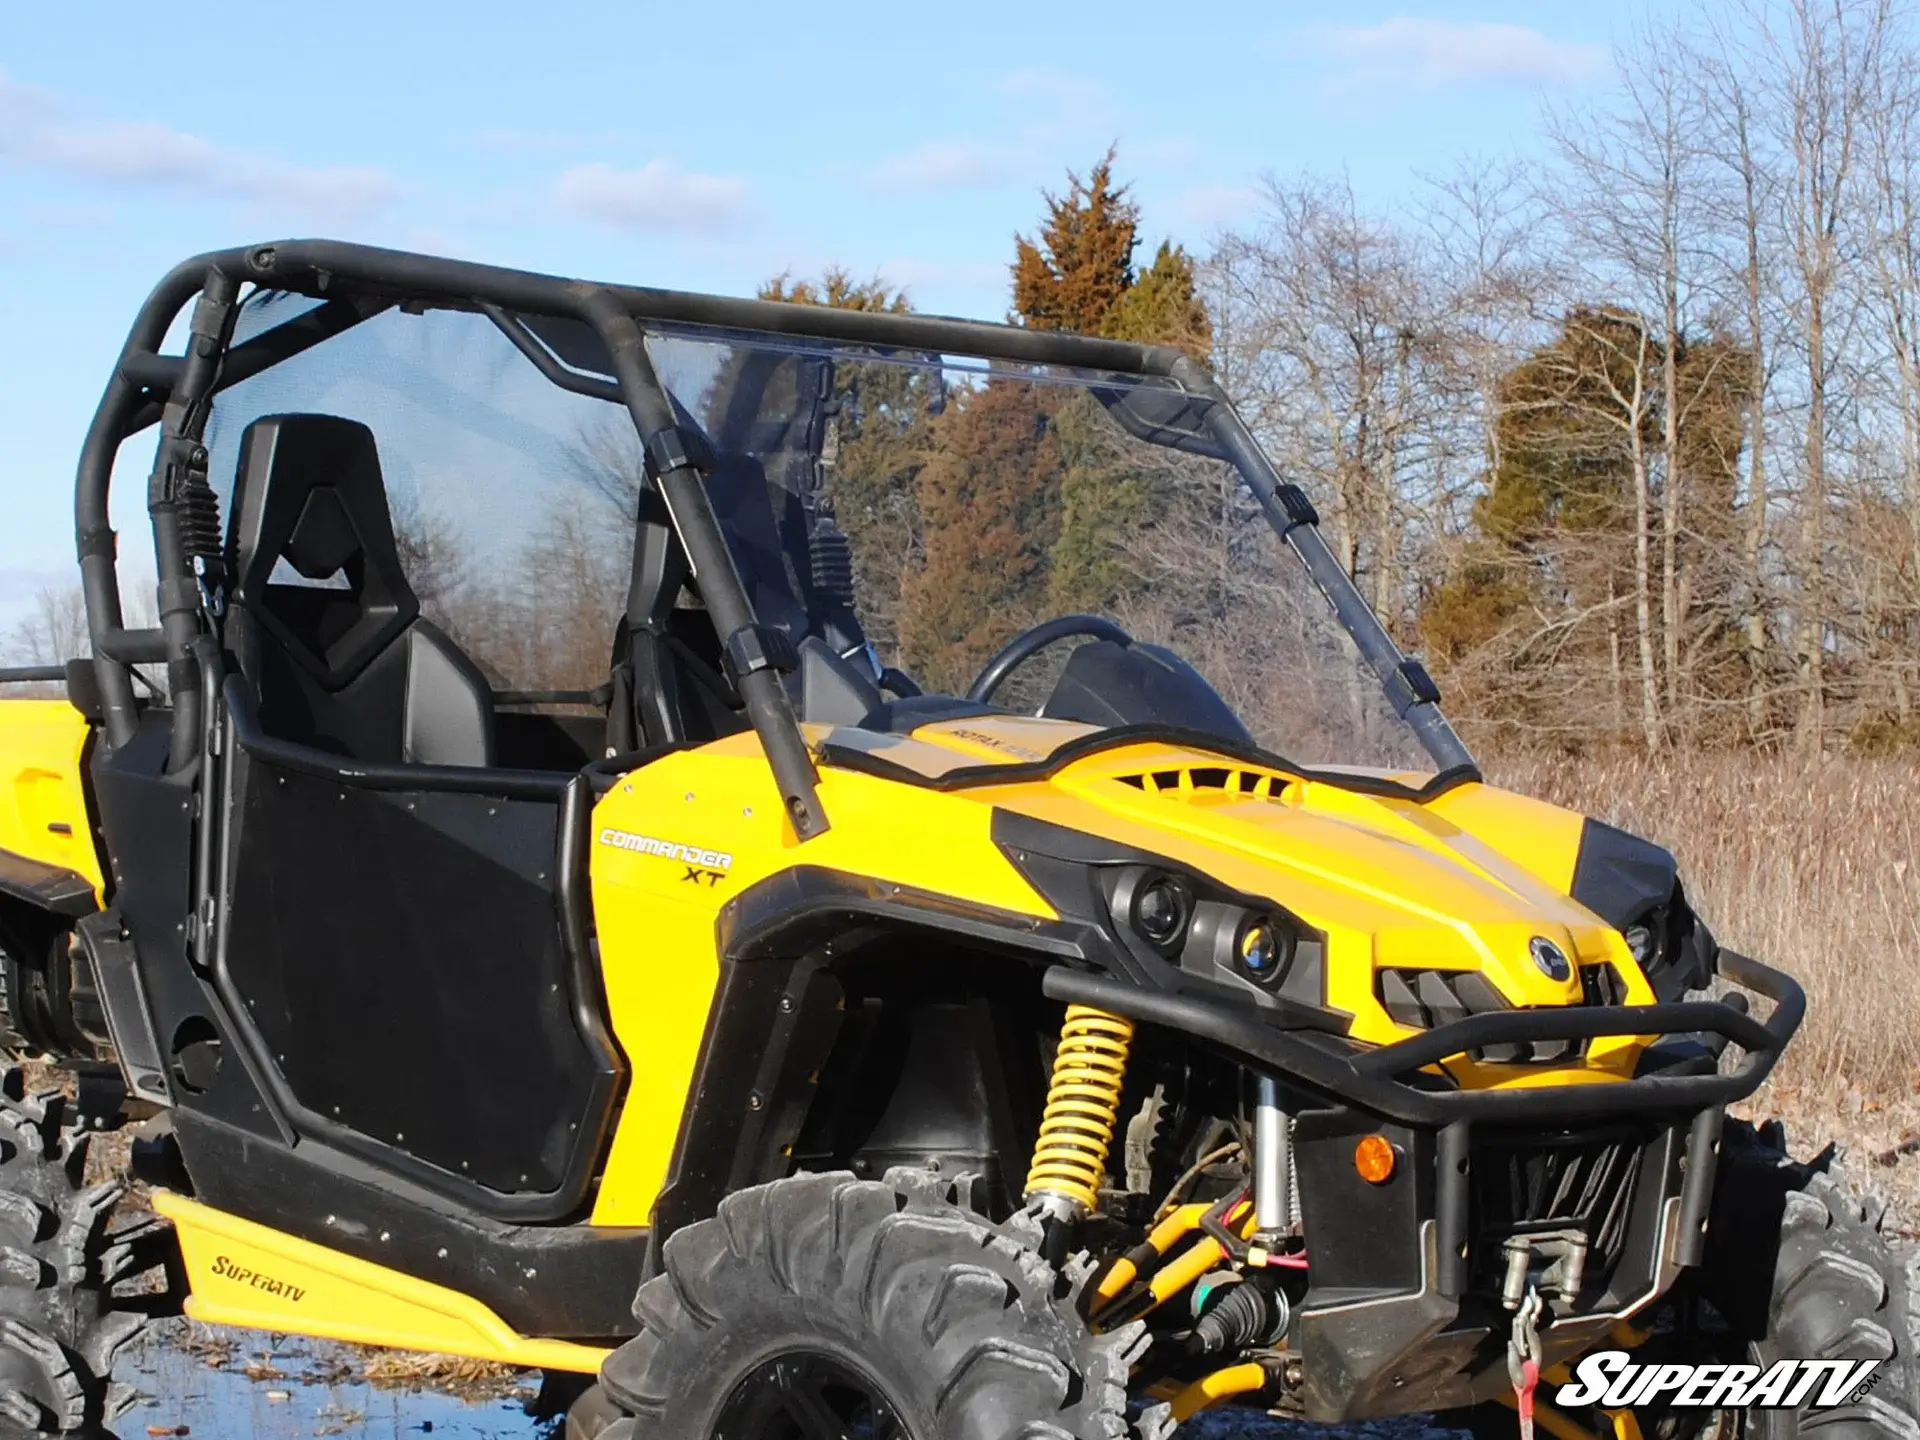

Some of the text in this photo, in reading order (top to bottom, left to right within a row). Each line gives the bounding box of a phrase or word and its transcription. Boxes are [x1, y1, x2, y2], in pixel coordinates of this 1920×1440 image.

[599, 827, 734, 870] COMMANDER
[680, 867, 726, 888] XT
[211, 1255, 306, 1302] SUPERATV
